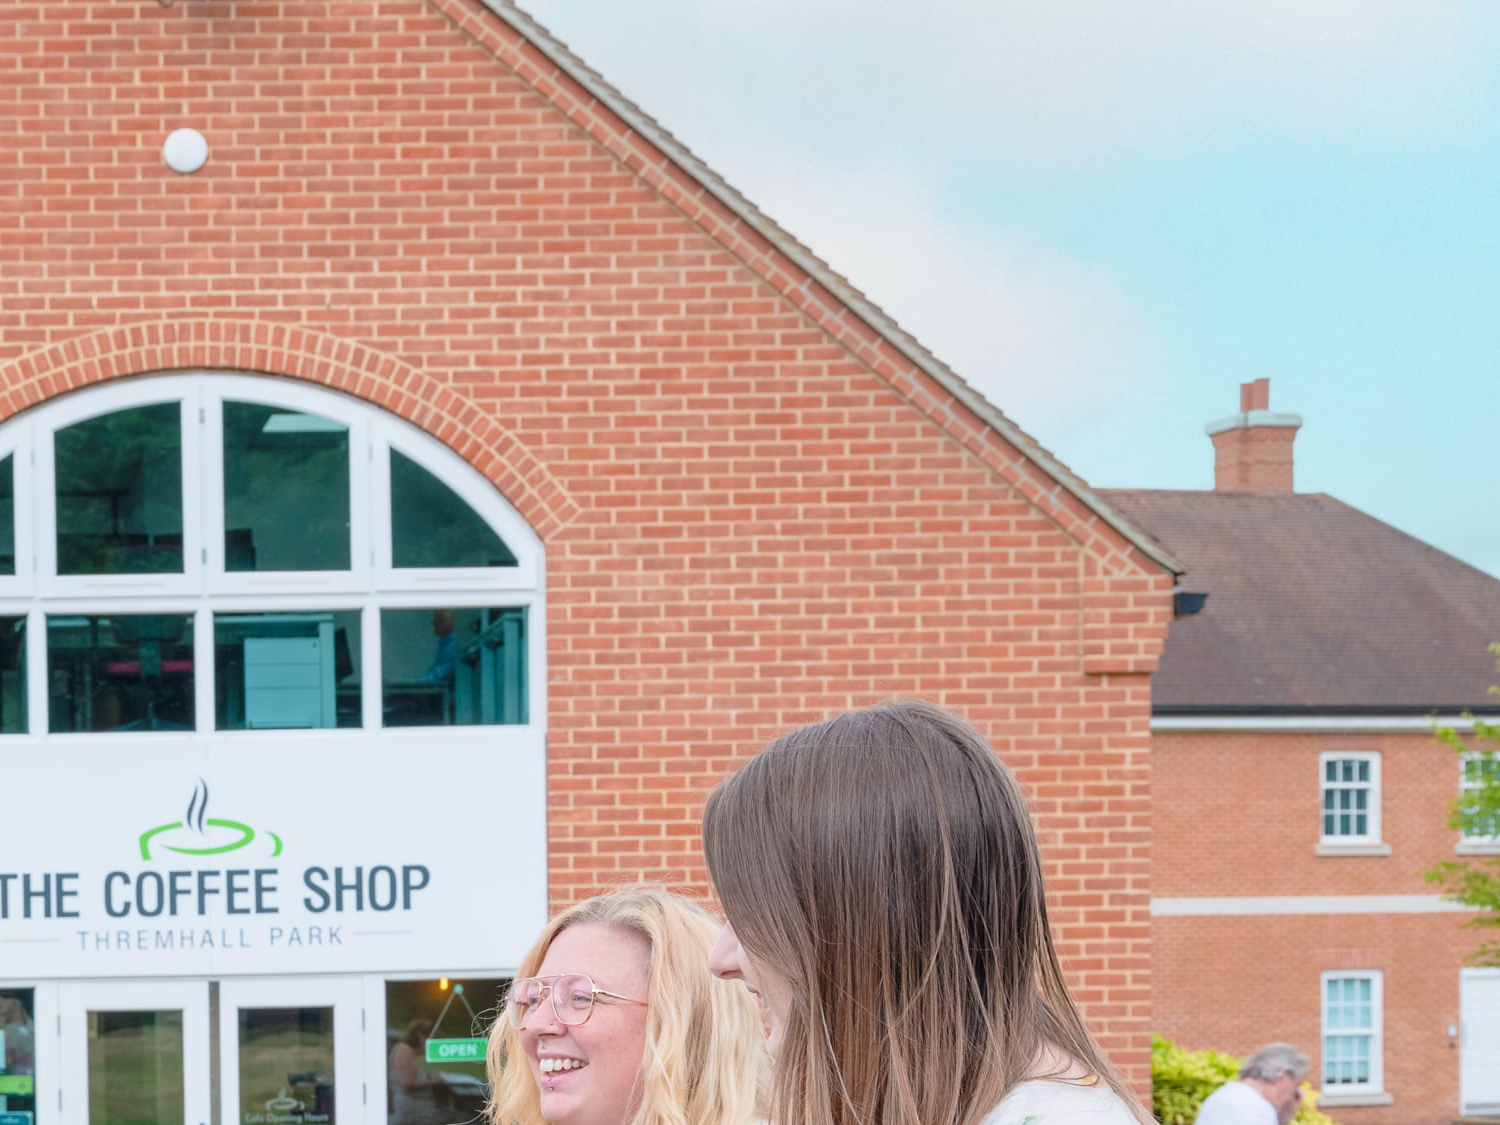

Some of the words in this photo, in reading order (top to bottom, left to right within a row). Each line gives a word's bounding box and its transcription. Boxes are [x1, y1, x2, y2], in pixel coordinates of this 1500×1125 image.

[104, 869, 279, 918] COFFEE
[303, 864, 430, 913] SHOP
[78, 929, 251, 951] THREMHALL
[270, 925, 343, 946] PARK
[438, 1043, 478, 1057] OPEN
[266, 1112, 303, 1124] Opening
[304, 1111, 329, 1122] Hours
